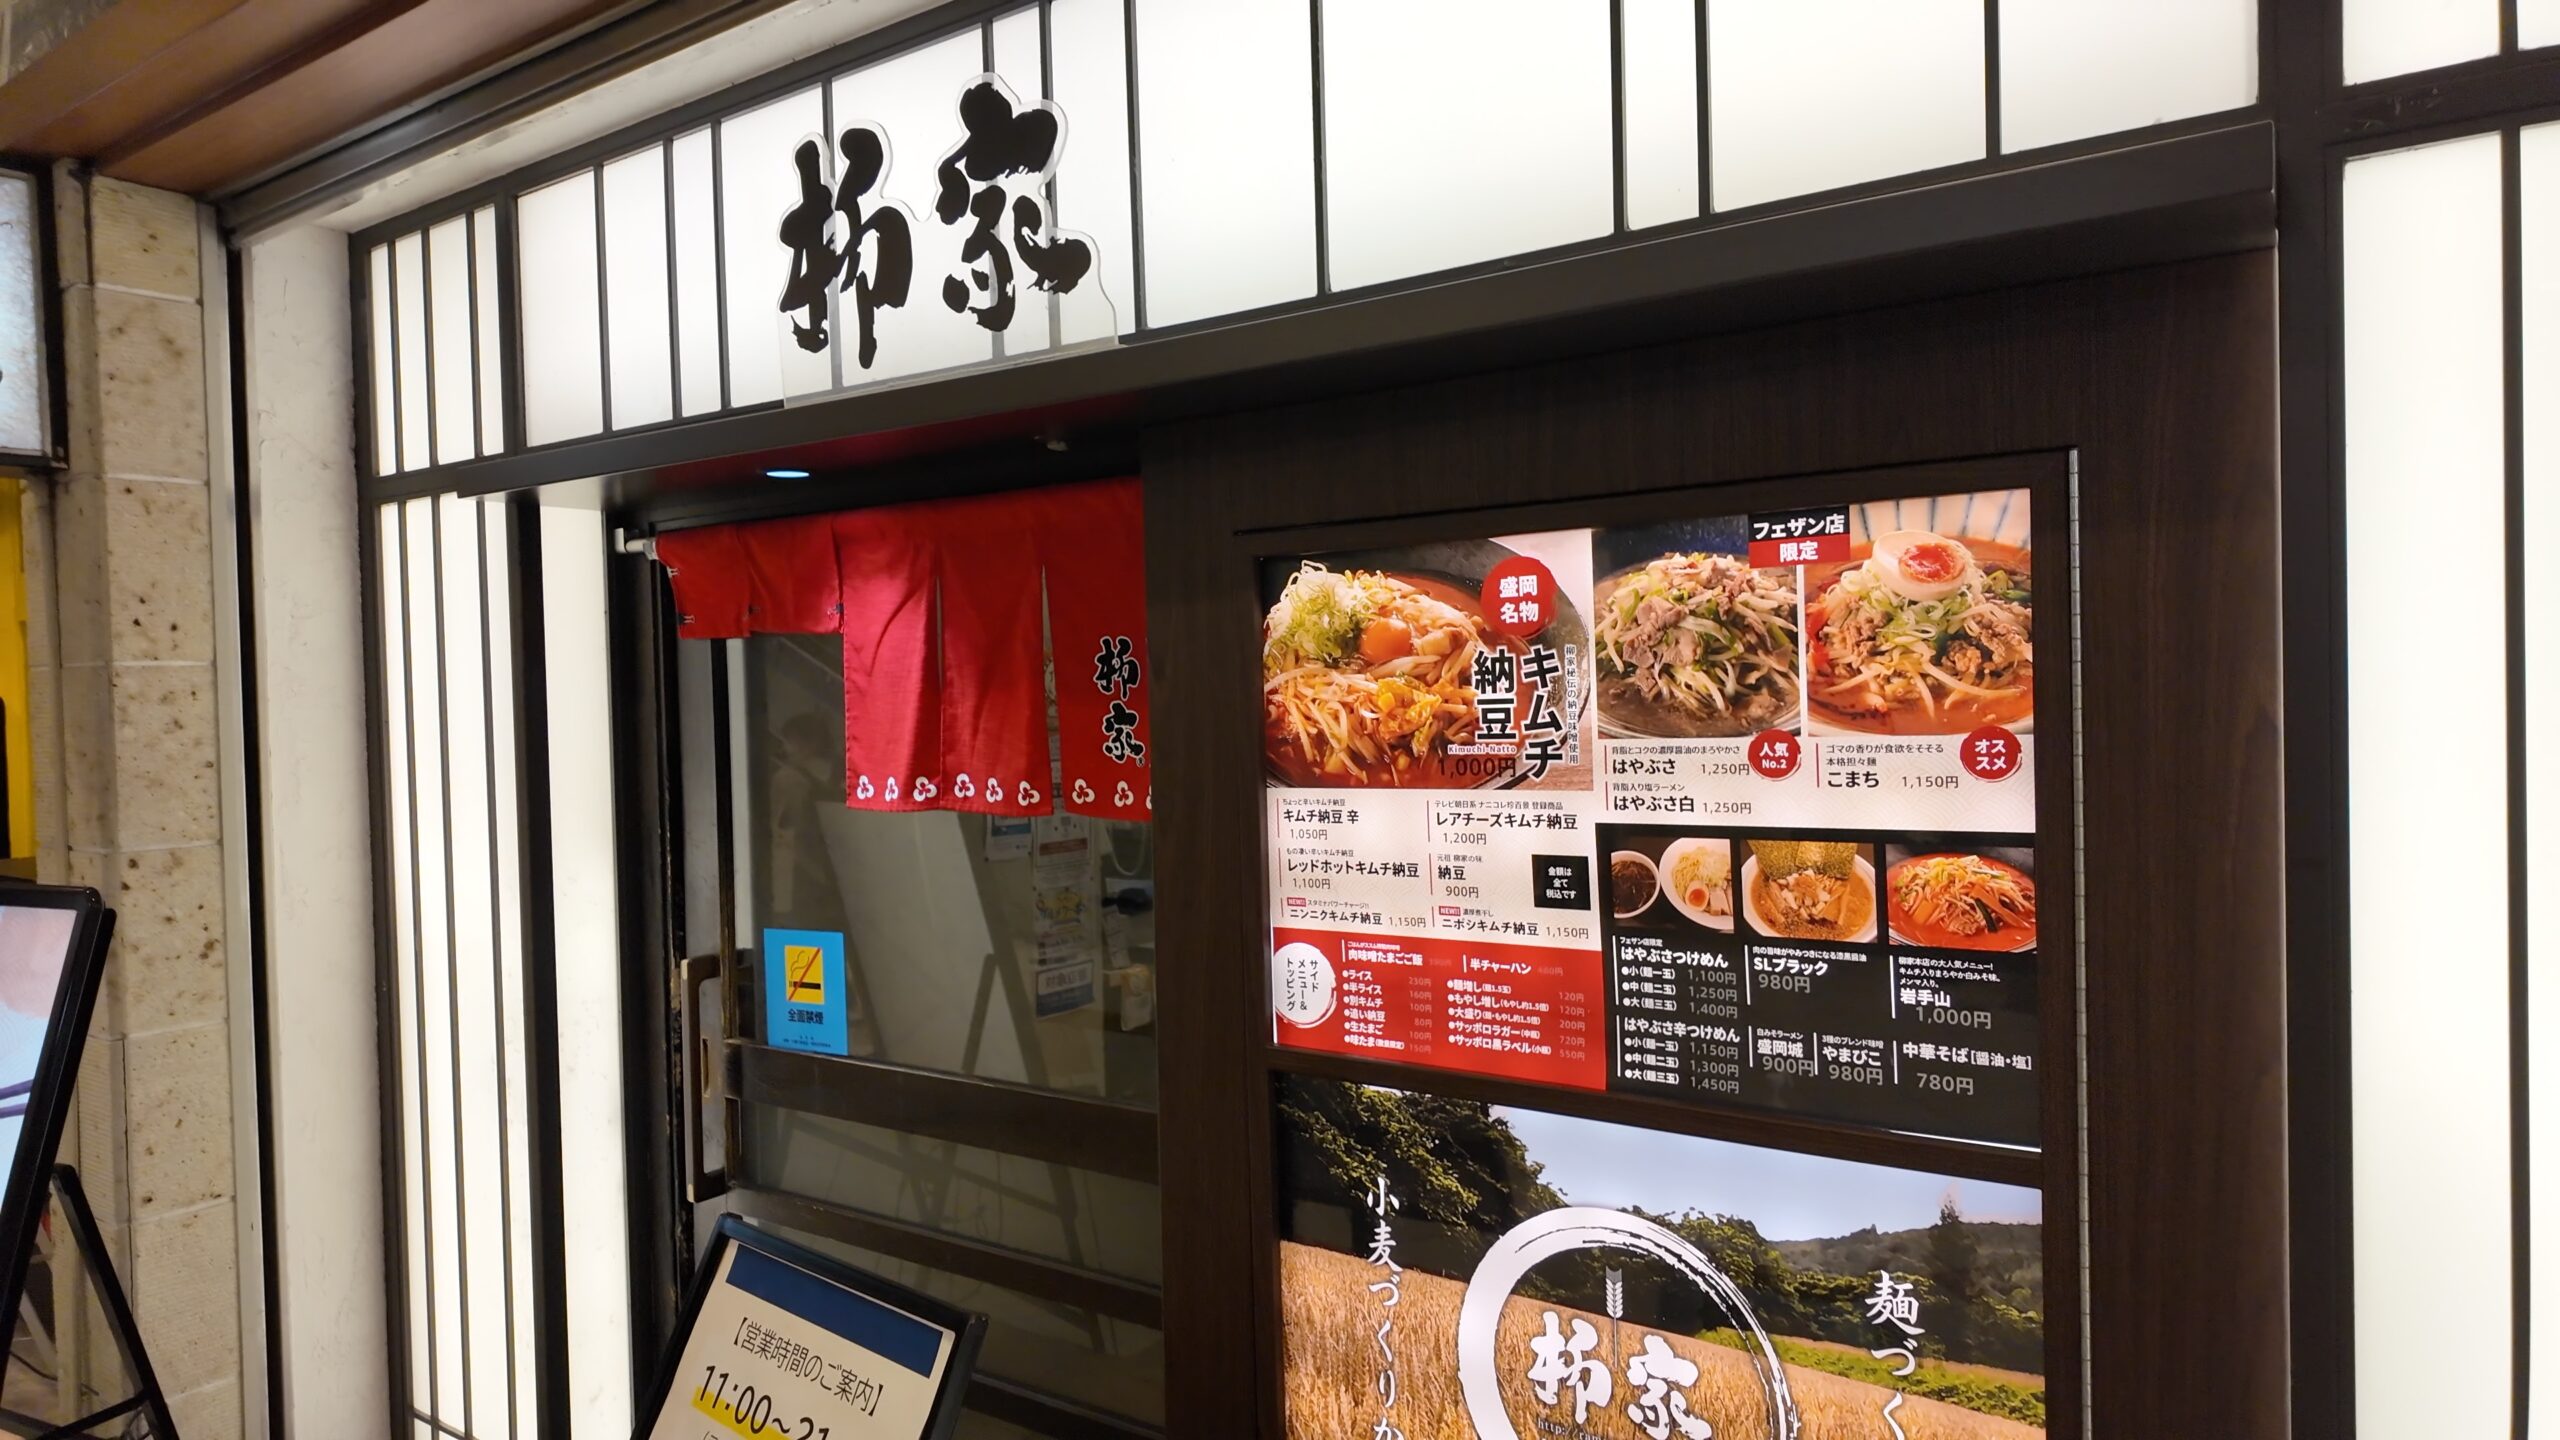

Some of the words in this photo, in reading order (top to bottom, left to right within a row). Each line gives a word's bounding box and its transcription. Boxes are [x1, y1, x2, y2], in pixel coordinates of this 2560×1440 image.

[1754, 513, 1845, 540] フェザン店
[1780, 540, 1818, 563] 限定
[1499, 575, 1538, 598] 盛岡
[1500, 602, 1539, 623] 名物
[1474, 649, 1517, 740] 納豆
[1523, 648, 1563, 779] キムチ
[1759, 742, 1789, 758] 人気
[1826, 744, 1944, 754] ゴマの香りが食欲をそそる
[1975, 738, 2006, 753] オス
[1438, 758, 1516, 778] 1,000円
[1612, 758, 1676, 775] はやぶさ
[1701, 763, 1750, 776] 1,250円
[1762, 759, 1787, 769] No.2
[1976, 756, 2007, 770] スメ
[1828, 771, 1879, 788] こまち
[1902, 776, 1959, 789] 1,150円
[1613, 795, 1694, 813] はやぶさ白
[1703, 802, 1751, 815] 1,250円
[1283, 809, 1343, 824] キムチ納豆
[1347, 810, 1359, 824] 辛
[1436, 812, 1578, 830] レアチーズキムチ納豆
[1290, 829, 1328, 840] 1,050円
[1443, 832, 1487, 845] 1,200円
[1288, 859, 1420, 878] レッドホットキムチ納豆
[1438, 865, 1466, 881] 納豆
[1548, 866, 1572, 876] 金額は
[1292, 878, 1331, 889] 1,100円
[1445, 886, 1479, 898] 900円
[1553, 878, 1568, 888] 全て
[1546, 889, 1576, 899] 税込です
[1290, 909, 1382, 925] ニンニクキムチ納豆
[1389, 917, 1426, 928] 1,150円
[1442, 918, 1539, 936] ニボシキムチ納豆
[1546, 927, 1589, 939] 1,150円
[1470, 958, 1531, 975] 半チャーハン
[1621, 946, 1729, 968] はやぶさつけめん
[1754, 957, 1828, 976] SLブラック
[1287, 958, 1296, 1011] トッピング
[1310, 959, 1319, 992] サイド
[1688, 969, 1737, 985] 1,100円
[1758, 973, 1811, 994] 980円
[1689, 986, 1738, 1002] 1,250円
[1900, 987, 1950, 1007] 岩手山
[788, 1008, 824, 1025] 全面禁煙
[1690, 1002, 1738, 1019] 1,400円
[1916, 1006, 1991, 1029] 1,000円
[1624, 1017, 1741, 1043] はやぶさ辛つけめん
[1757, 1028, 1804, 1040] 白みそラーメン
[1690, 1042, 1739, 1060] 1,150円
[1757, 1039, 1804, 1058] 盛岡城
[1822, 1046, 1882, 1067] やまびこ
[1690, 1060, 1739, 1078] 1,300円
[1762, 1056, 1814, 1077] 900円
[1829, 1065, 1883, 1086] 980円
[1691, 1076, 1739, 1094] 1,450円
[1917, 1072, 1973, 1096] 780円
[1366, 1177, 1404, 1440] 小麦づくりか
[1865, 1270, 1926, 1440] 麺づく
[733, 1316, 884, 1417] 【営業時間のご案内】
